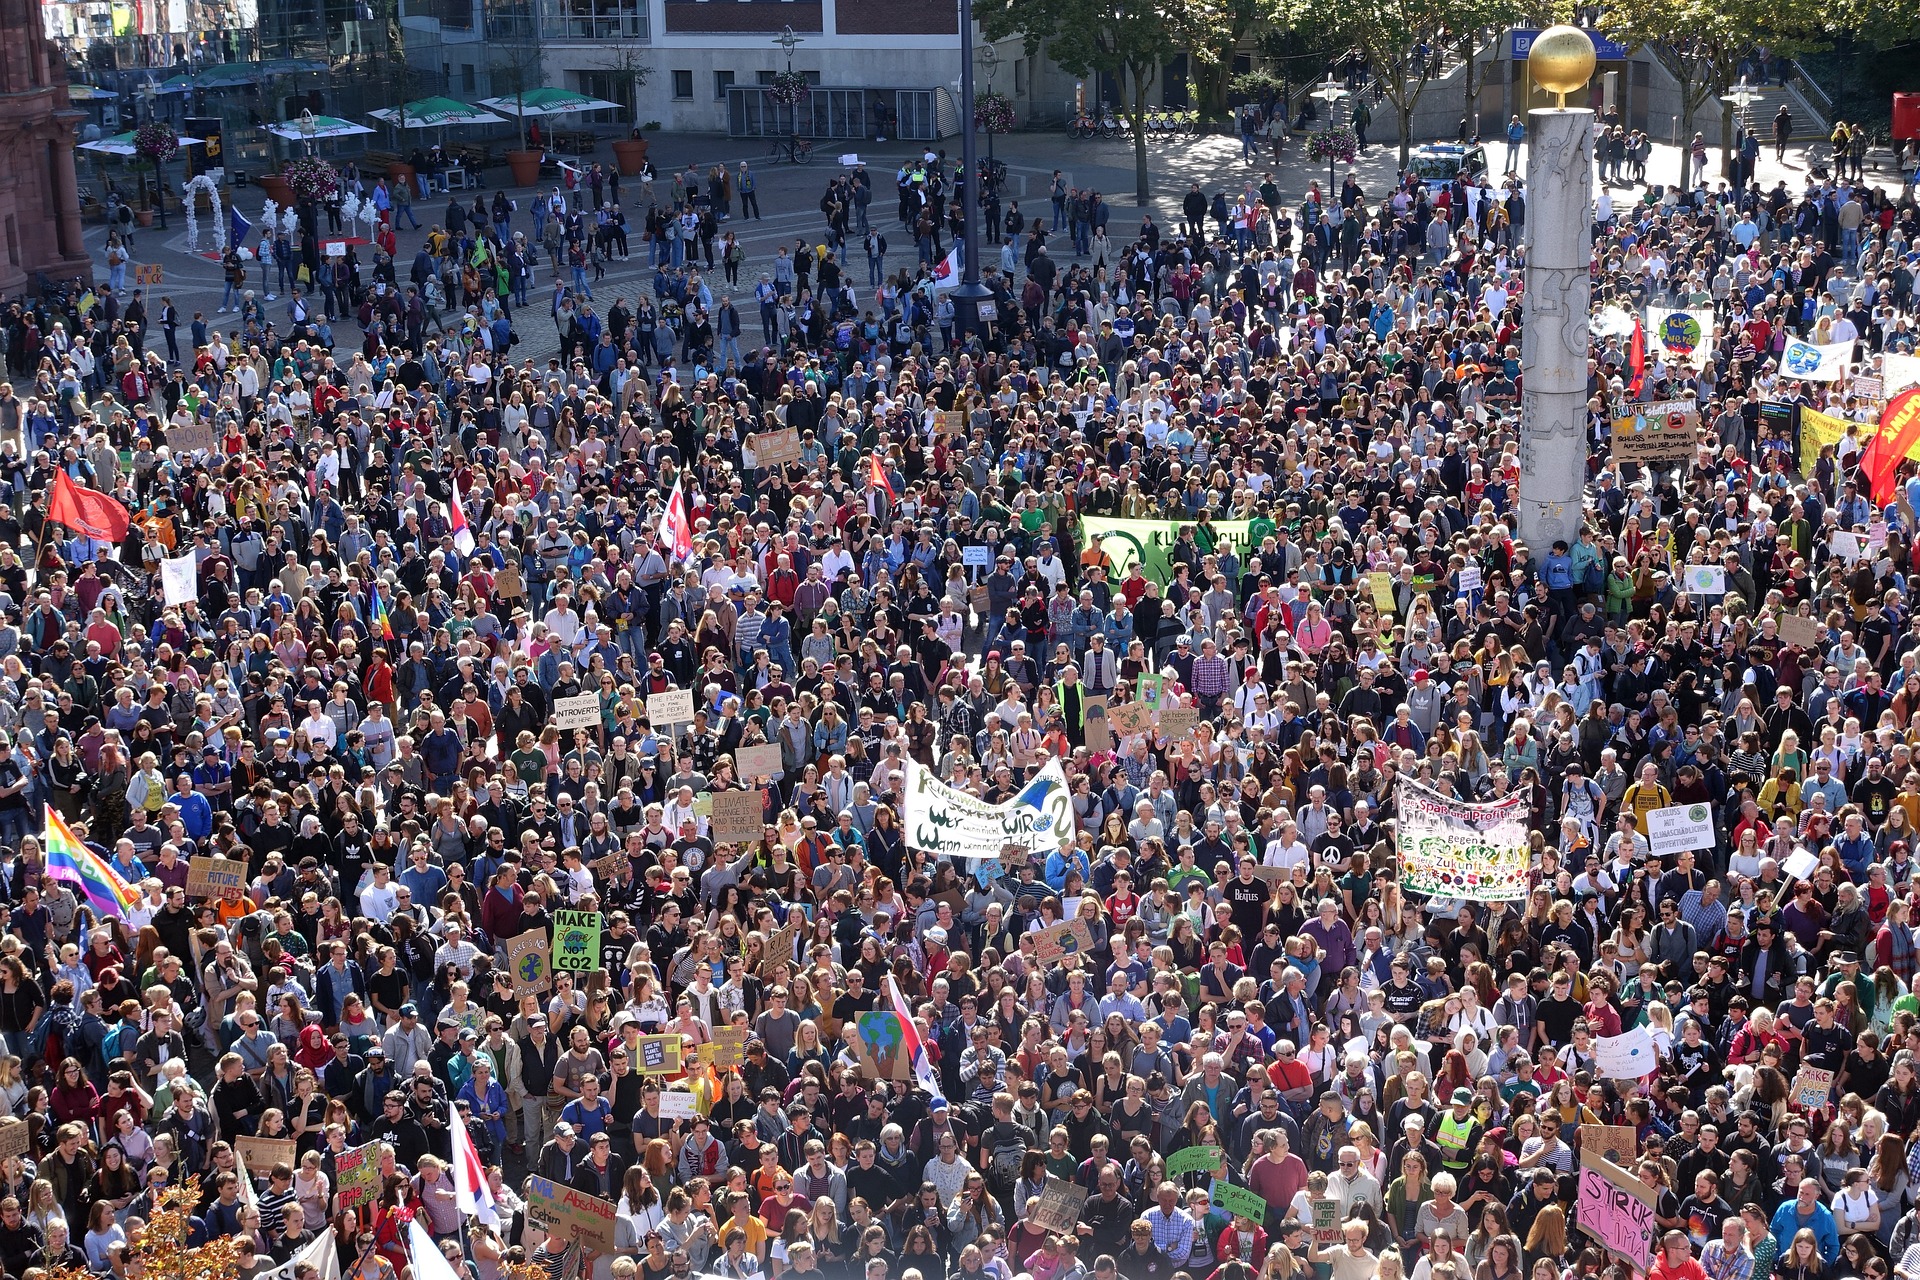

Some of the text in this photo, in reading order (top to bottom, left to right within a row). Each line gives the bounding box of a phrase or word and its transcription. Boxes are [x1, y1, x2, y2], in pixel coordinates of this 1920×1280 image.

[1612, 404, 1646, 420] BUNT
[1667, 400, 1696, 415] BRAUN
[1617, 434, 1645, 442] SCHLUSS
[1413, 576, 1425, 584] NO
[666, 693, 690, 702] PLANET
[556, 706, 600, 718] INTROVERTS
[713, 796, 750, 808] CLIMATE
[713, 806, 742, 818] CHANGE
[1420, 799, 1449, 816] Spaß
[1451, 809, 1471, 821] und
[1473, 810, 1506, 822] Profit
[1655, 809, 1681, 818] SCHLUSS
[714, 818, 728, 827] AND
[729, 816, 748, 825] THERE
[930, 805, 964, 829] Wer
[917, 823, 962, 852] Wann
[1448, 835, 1478, 845] gegen
[211, 860, 244, 872] EARTH
[1436, 857, 1483, 872] Zukunft
[208, 870, 241, 887] FUTURE
[216, 888, 244, 900] LIFES
[1234, 888, 1259, 903] BEATLES
[556, 911, 597, 928] MAKE
[557, 926, 594, 942] Love
[534, 939, 546, 950] NO
[563, 946, 588, 955] NOT
[558, 956, 592, 970] CO2
[514, 975, 551, 997] PLANET B
[1803, 1069, 1830, 1083] MAKE
[1801, 1077, 1829, 1090] LOVE
[1801, 1087, 1826, 1097] NOT
[1800, 1095, 1825, 1107] CO2
[1608, 1127, 1622, 1139] BE
[1584, 1138, 1601, 1150] AT
[531, 1177, 617, 1221] Mit Abschalten
[1229, 1190, 1248, 1202] gibt
[1226, 1199, 1254, 1215] Planet
[1585, 1171, 1654, 1235] STREIK
[529, 1206, 606, 1244] Gehirn gemeint
[1580, 1197, 1647, 1268] KLIMA
